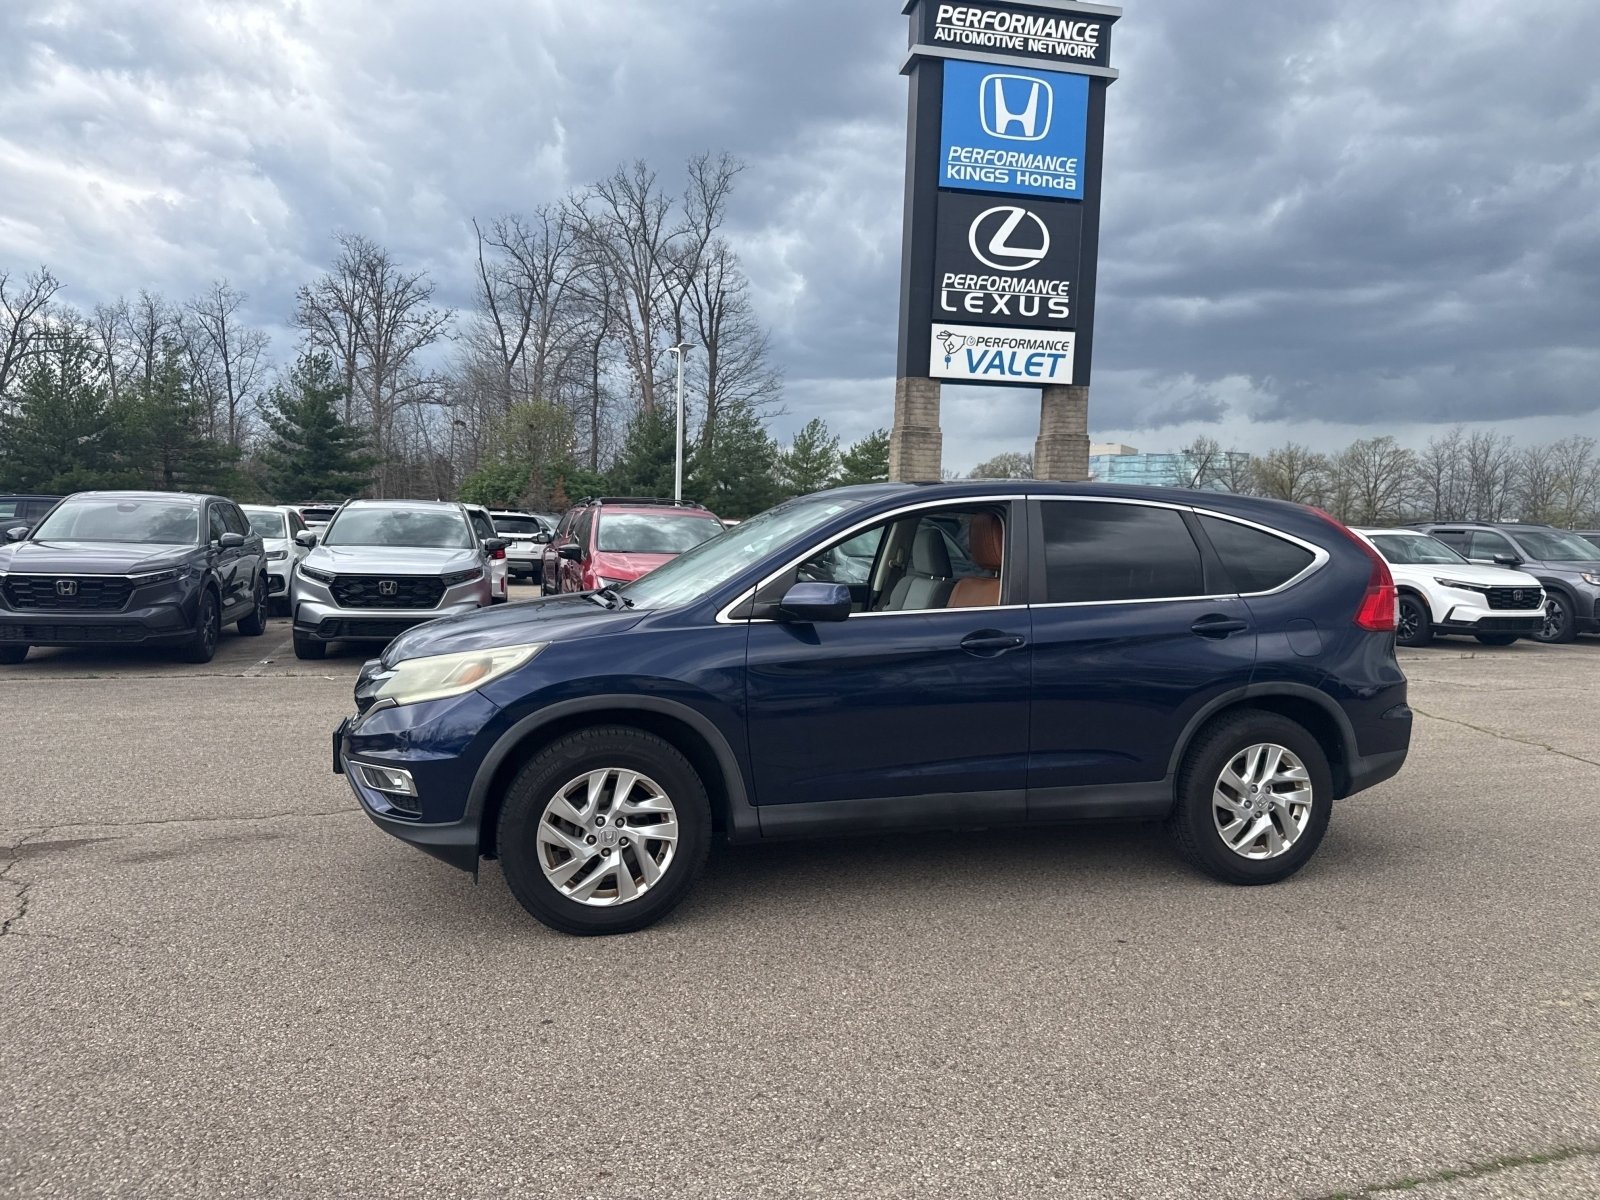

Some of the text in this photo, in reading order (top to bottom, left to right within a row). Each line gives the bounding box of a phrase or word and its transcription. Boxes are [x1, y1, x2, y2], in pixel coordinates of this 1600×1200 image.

[936, 5, 1100, 42] PERFORMANCE
[934, 28, 1096, 59] AUTOMOTIVE NETWORK
[948, 146, 1078, 172] PERFORMANCE
[947, 165, 1076, 190] KINGS Honda
[942, 273, 1070, 295] PERFORMANCE
[941, 290, 1070, 318] LEXUS
[976, 336, 1070, 351] PERFORMANCE
[966, 348, 1067, 378] VALET
